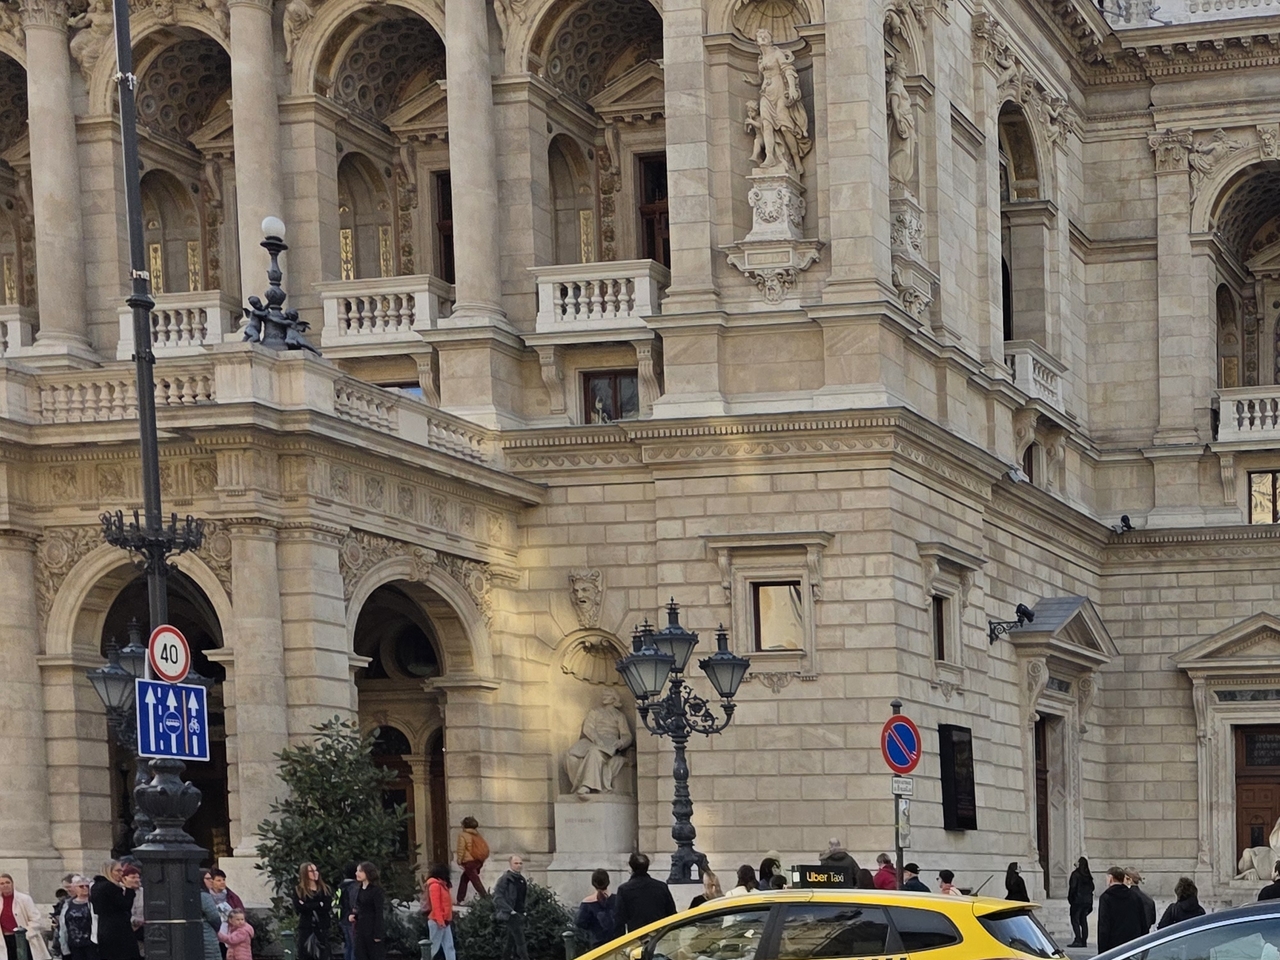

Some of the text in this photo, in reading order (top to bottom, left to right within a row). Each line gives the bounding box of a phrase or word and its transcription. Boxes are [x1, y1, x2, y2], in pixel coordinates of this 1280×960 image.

[160, 643, 179, 665] 40
[806, 871, 845, 883] Uber Taxi
